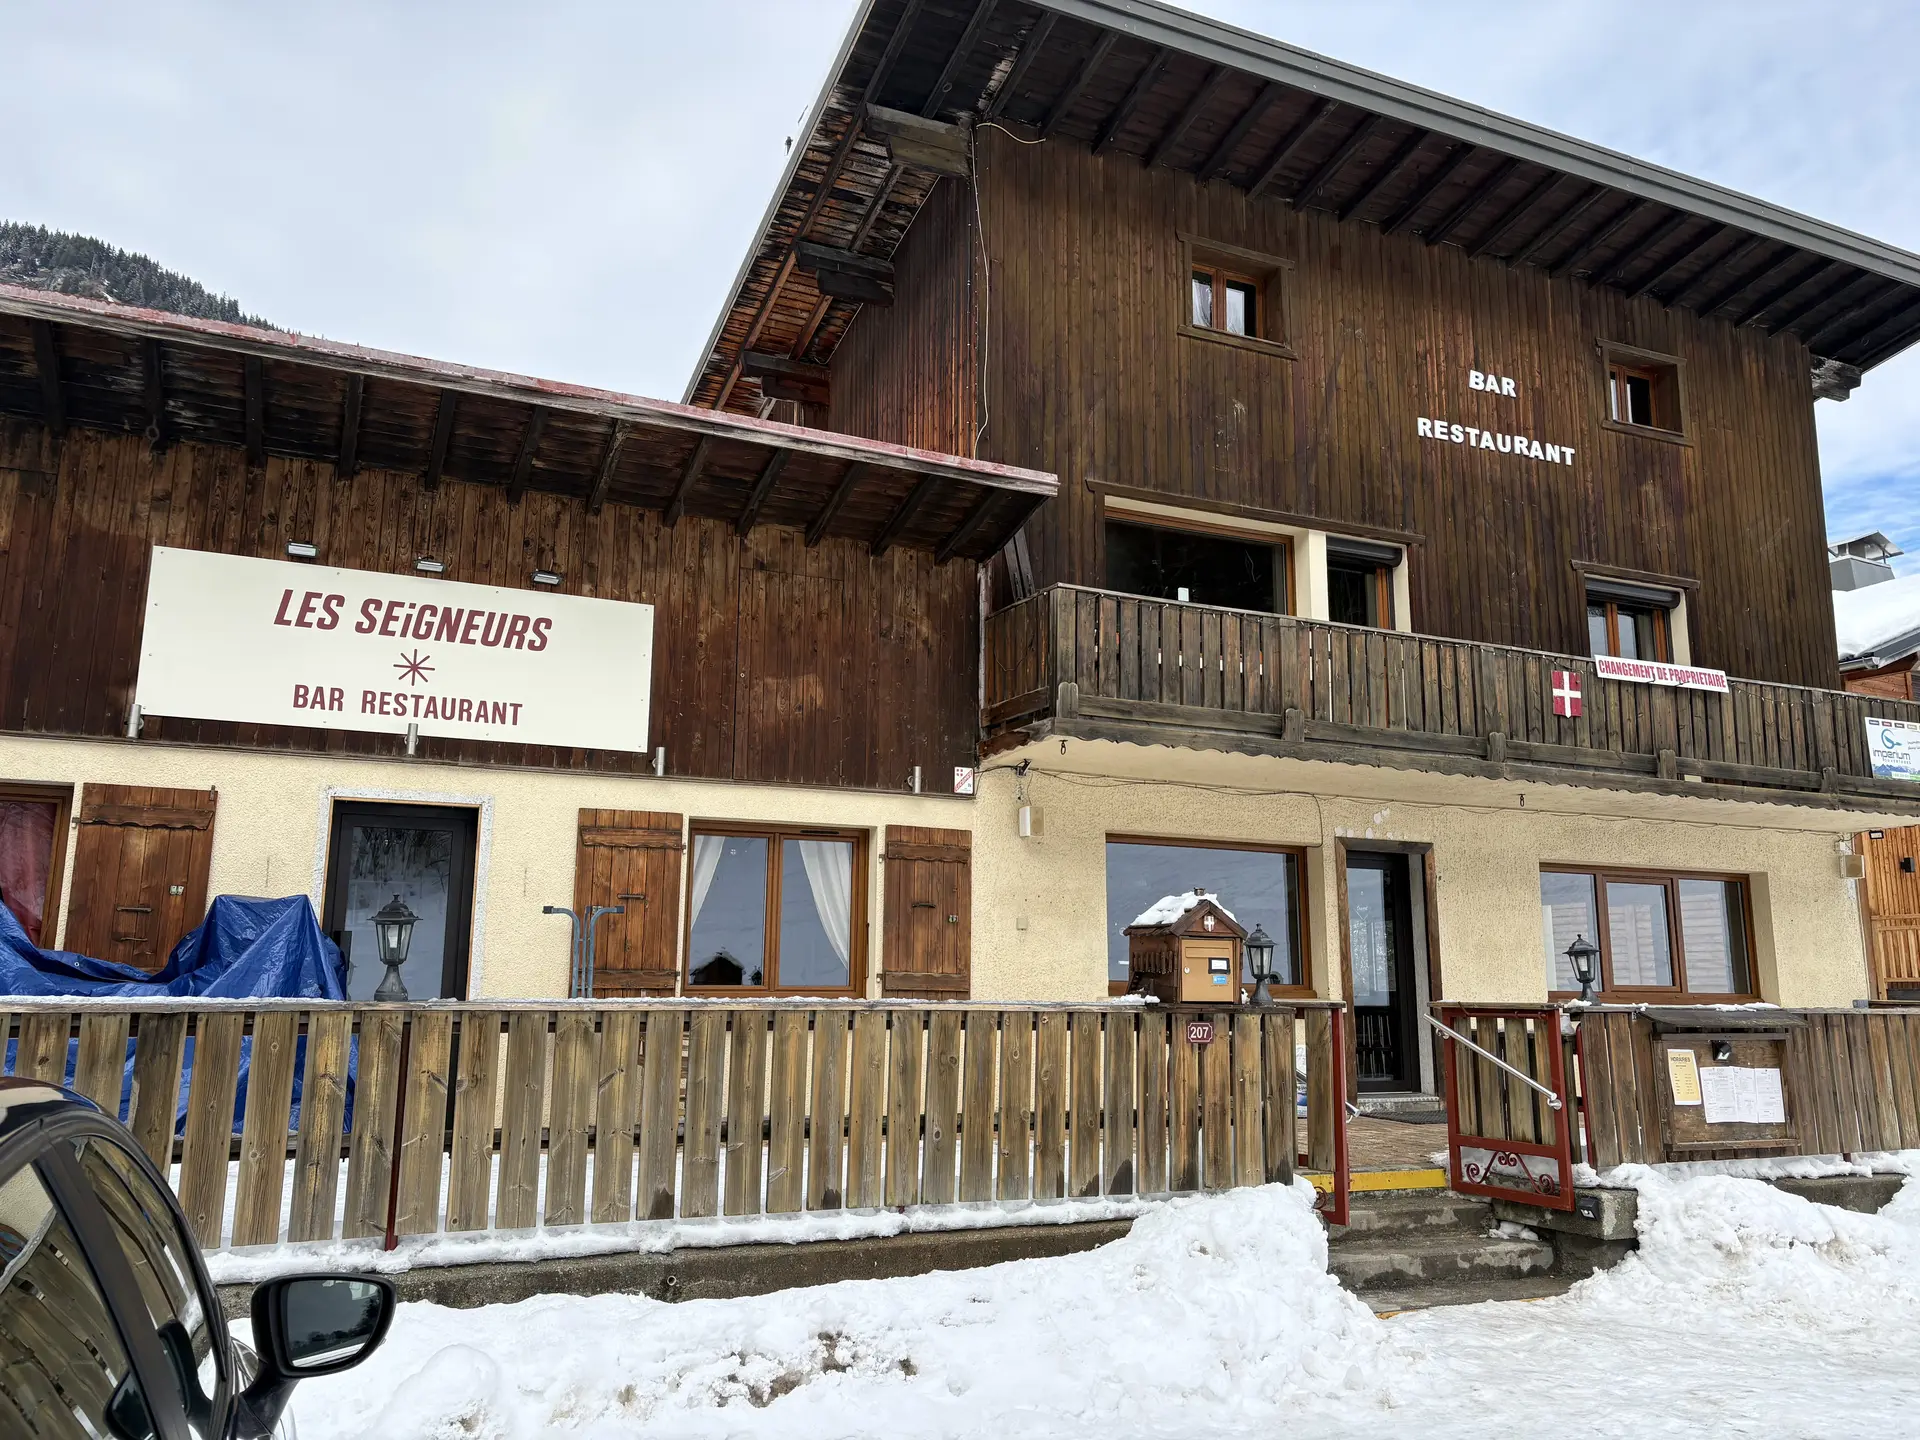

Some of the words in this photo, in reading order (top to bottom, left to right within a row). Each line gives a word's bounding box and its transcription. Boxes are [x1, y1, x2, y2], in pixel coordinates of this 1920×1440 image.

[1468, 369, 1517, 398] BAR
[1417, 416, 1575, 466] RESTAURANT
[273, 588, 346, 631] LES
[1598, 660, 1655, 679] CHANGEMENT
[1656, 667, 1669, 681] DE
[1669, 668, 1726, 688] PROPRIETAIRE
[292, 684, 345, 712] BAR
[360, 690, 523, 726] RESTAURANT
[1873, 748, 1911, 761] imperium
[1190, 1026, 1209, 1039] 207
